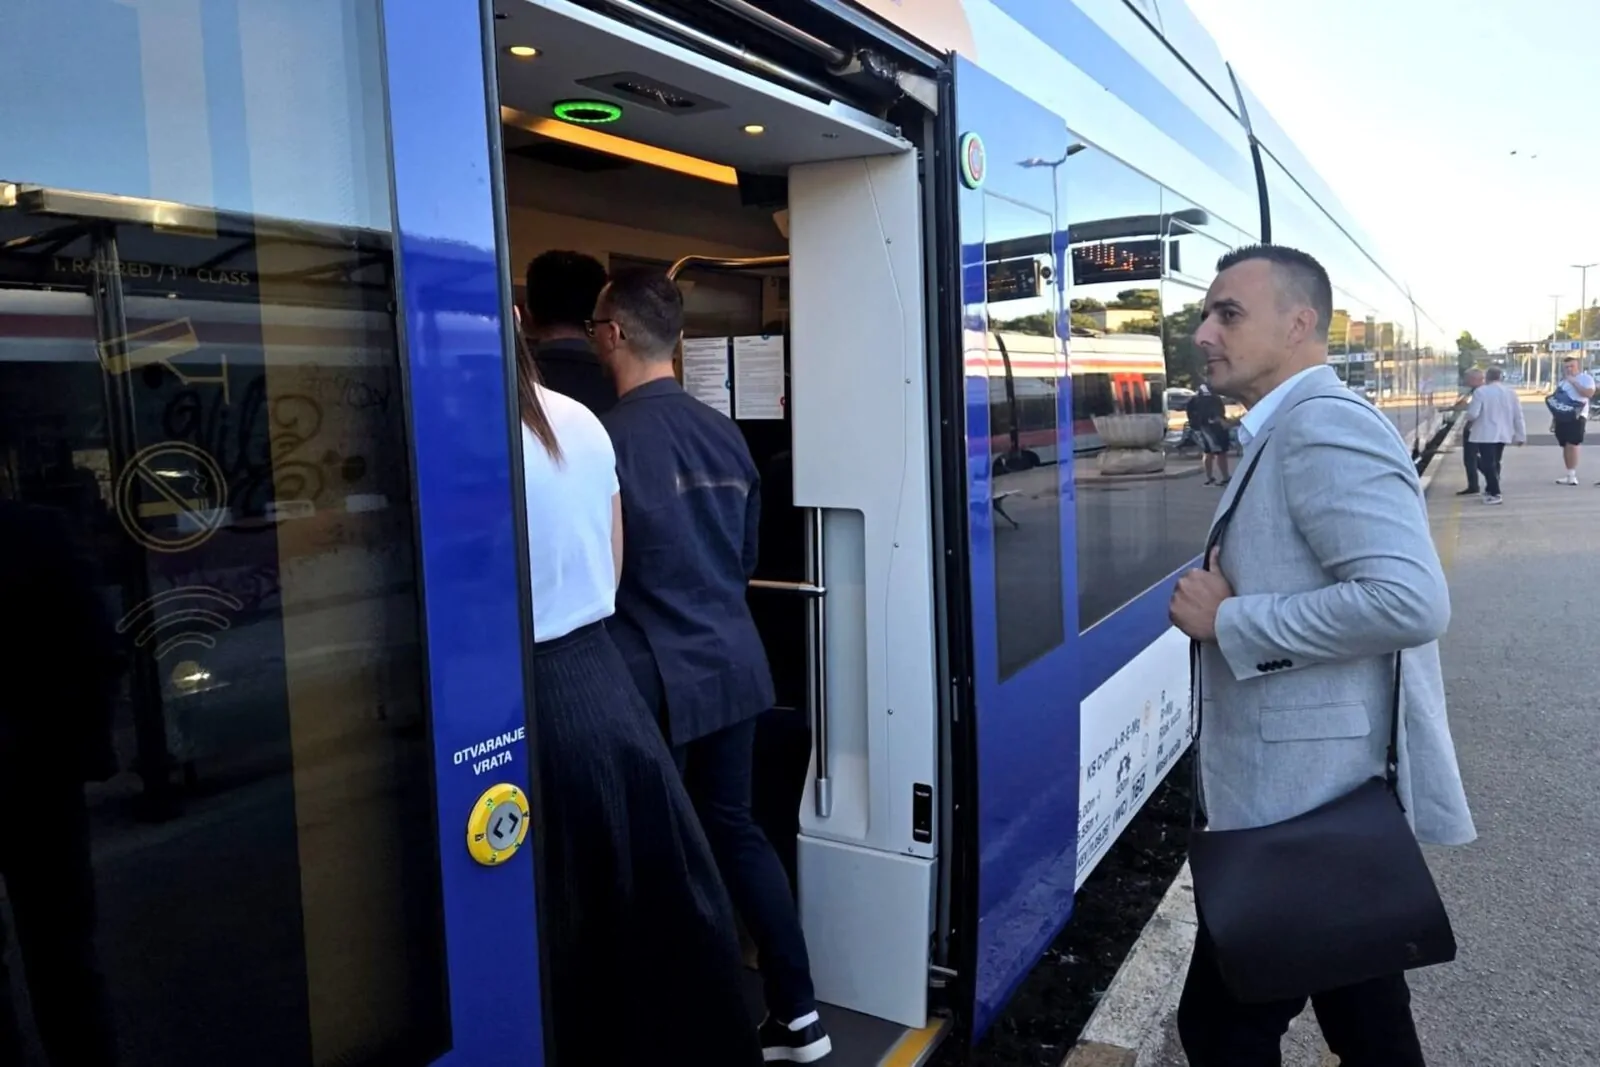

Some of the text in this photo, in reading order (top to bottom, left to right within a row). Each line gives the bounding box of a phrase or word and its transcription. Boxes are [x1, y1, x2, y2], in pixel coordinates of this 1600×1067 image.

[197, 268, 250, 286] CLASS
[453, 726, 525, 766] OTVARANJE
[472, 750, 513, 776] VRATA
